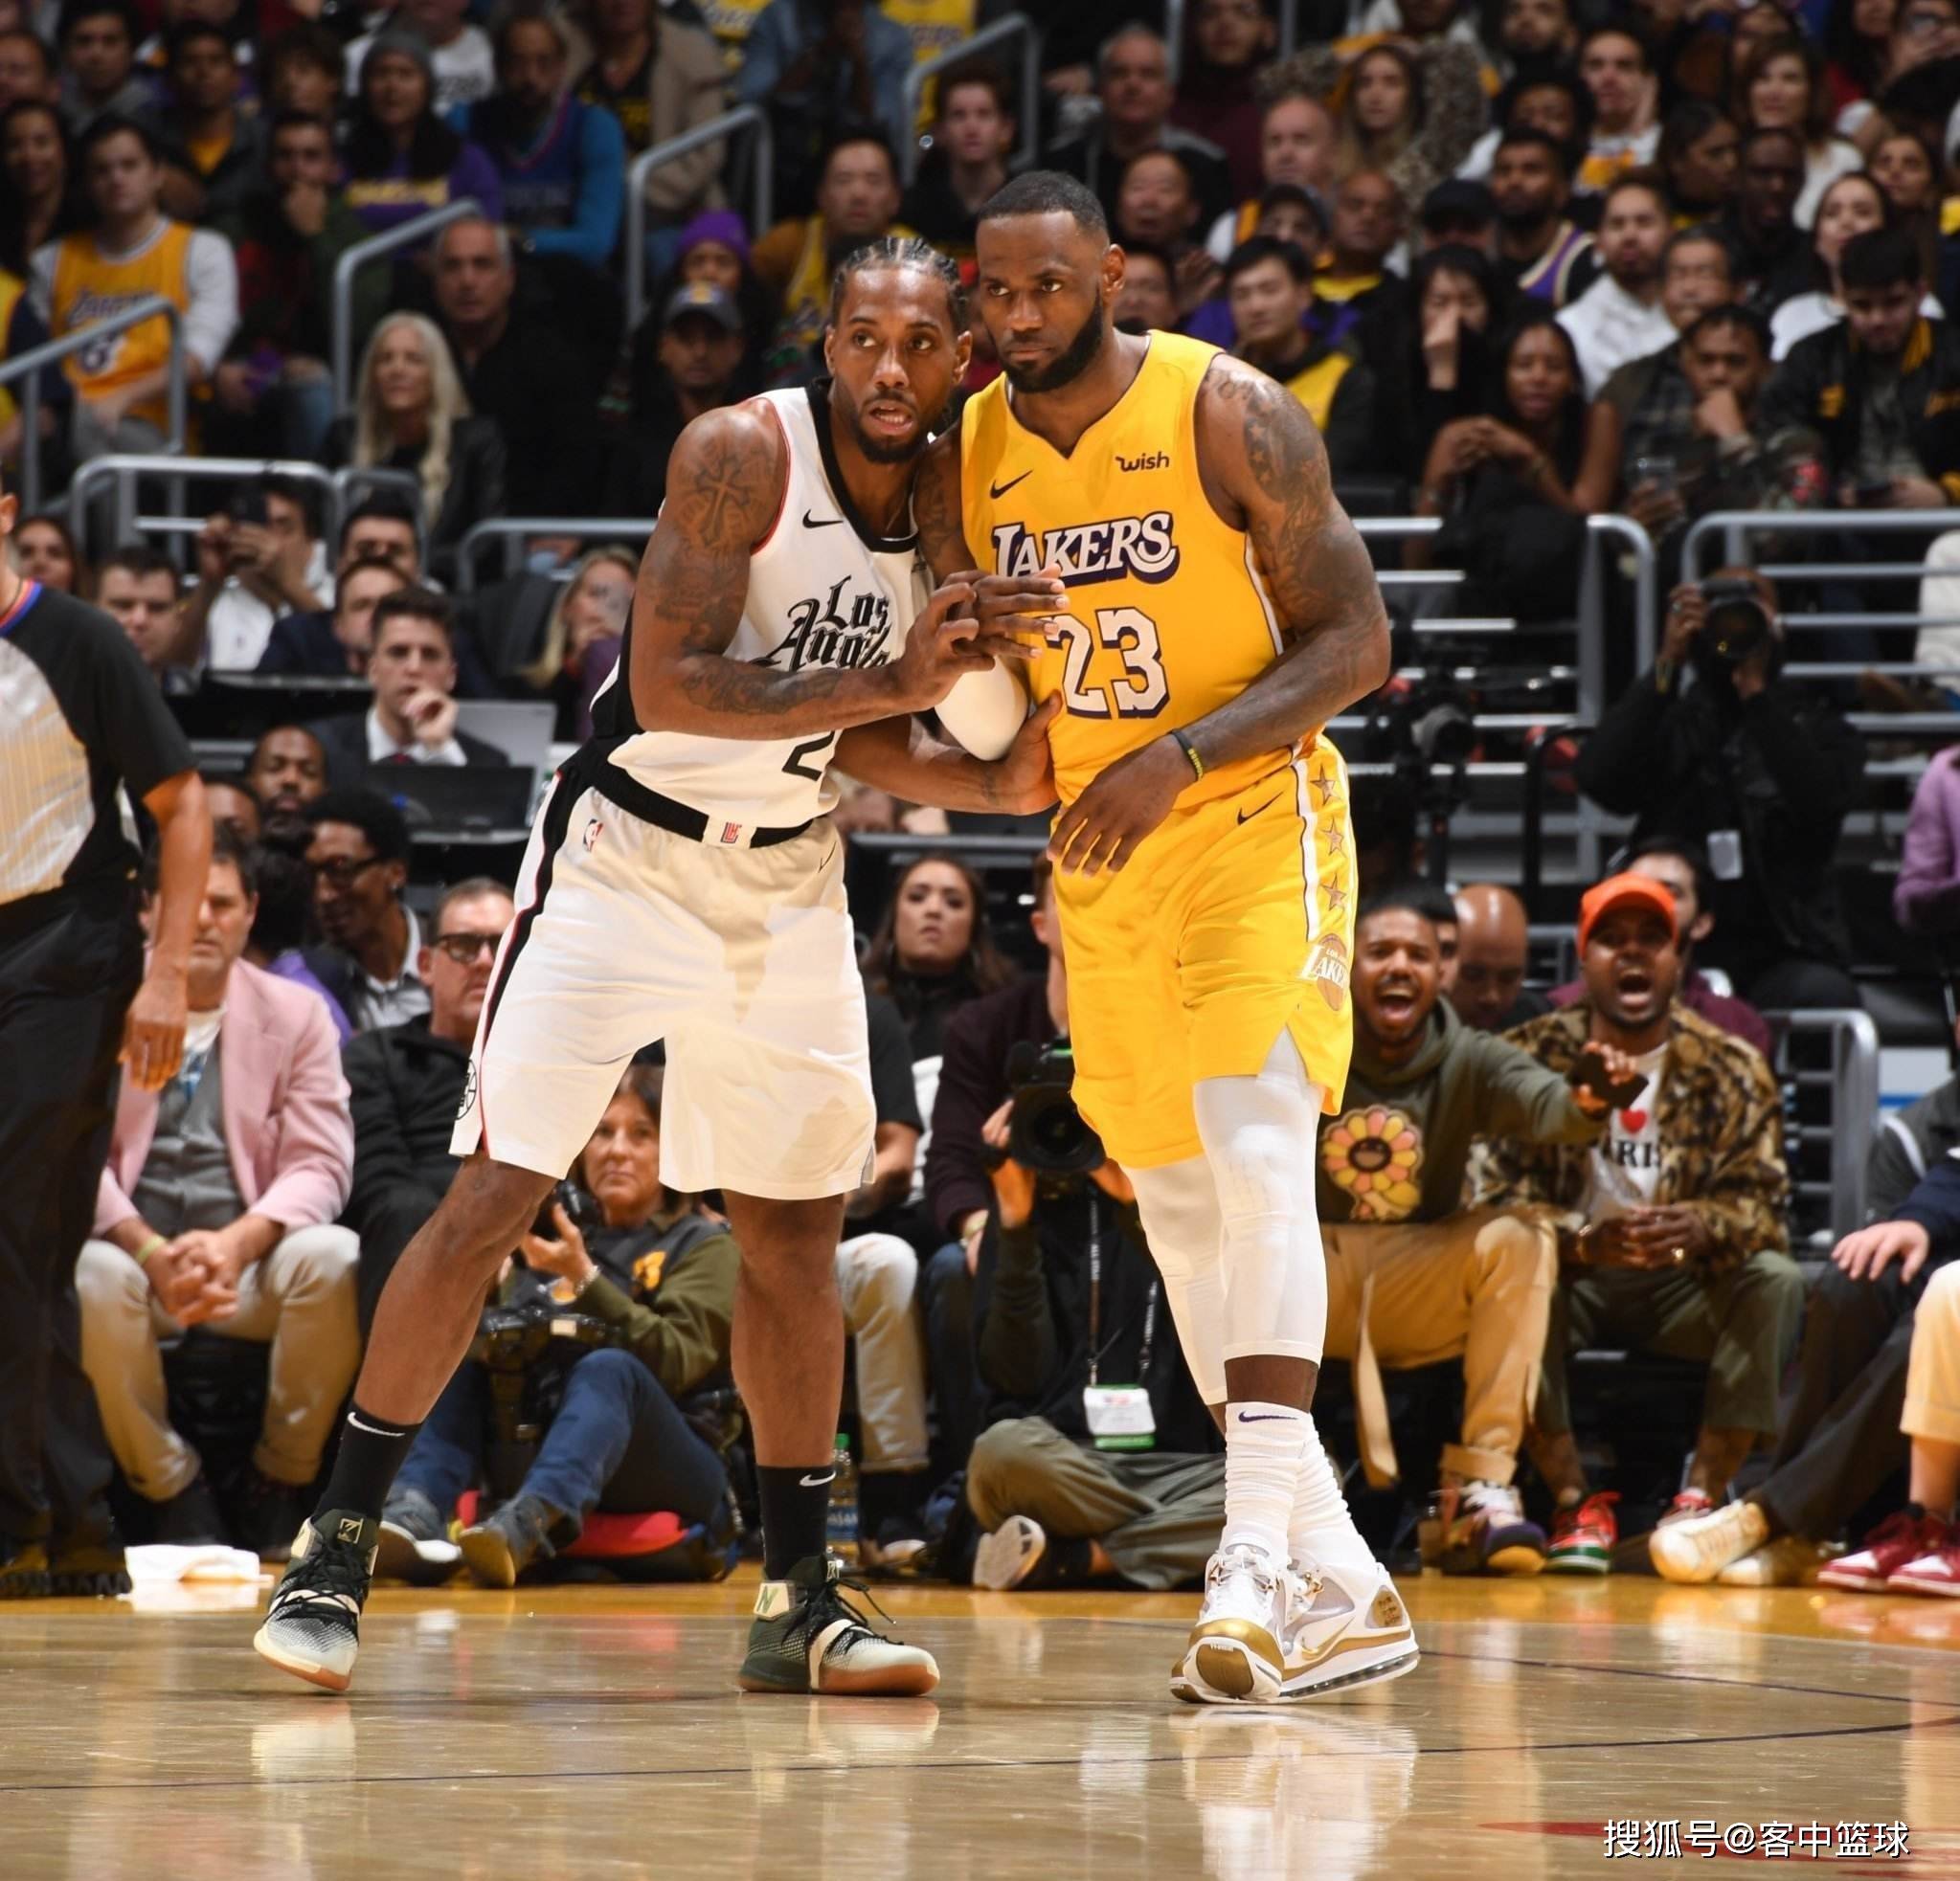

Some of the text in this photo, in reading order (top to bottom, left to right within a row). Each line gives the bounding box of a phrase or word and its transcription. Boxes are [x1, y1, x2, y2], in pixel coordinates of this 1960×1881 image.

[1115, 452, 1170, 472] wish
[992, 511, 1181, 588] LAKERS
[816, 574, 890, 634] Los
[1034, 606, 1170, 719] 23
